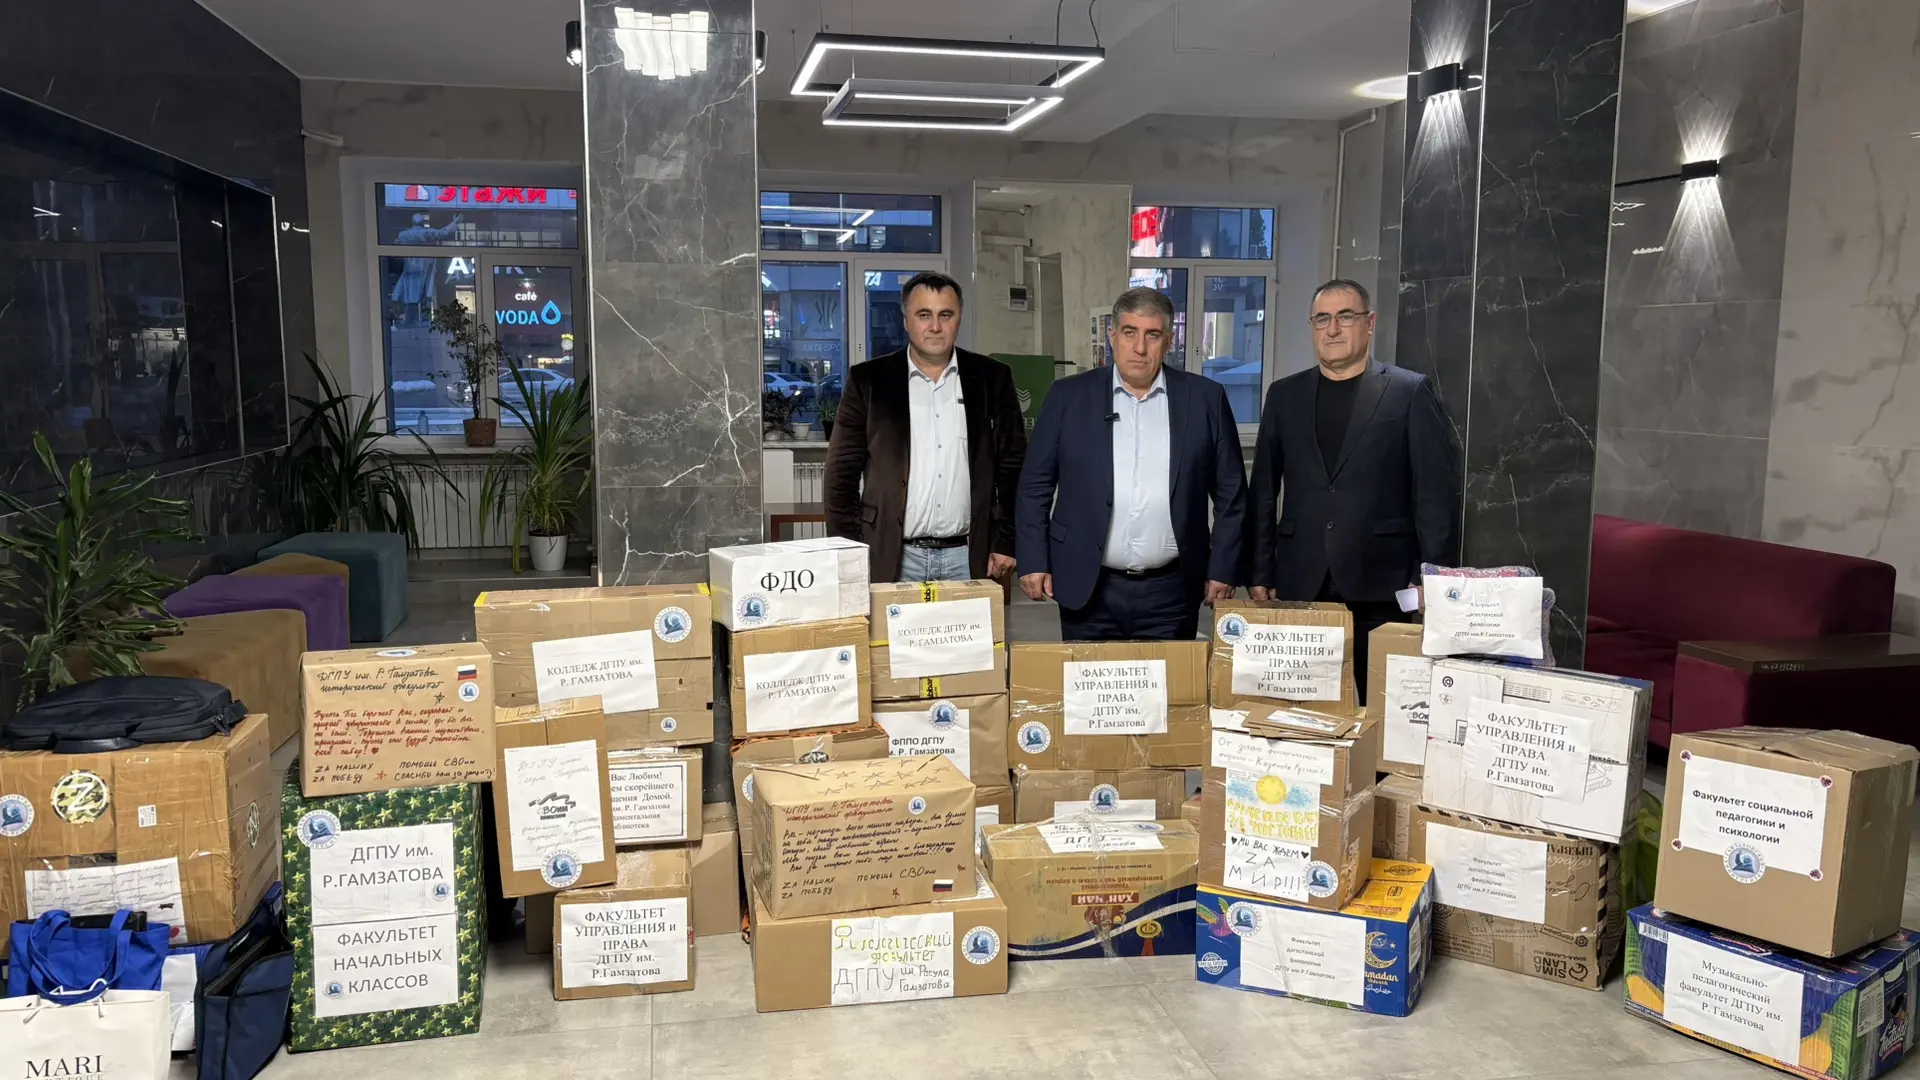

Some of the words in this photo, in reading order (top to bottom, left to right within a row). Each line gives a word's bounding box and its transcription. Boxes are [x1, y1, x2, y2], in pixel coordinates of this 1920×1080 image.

[515, 292, 537, 301] café
[495, 310, 539, 325] VODA
[760, 568, 814, 595] ФДО
[898, 624, 942, 638] КОЛЛЕДЖ
[943, 623, 966, 636] ДГПУ
[1254, 632, 1325, 643] ФАКУЛЬТЕТ
[908, 638, 918, 648] Р.
[920, 634, 973, 647] ГАМЗАТОВА
[1245, 644, 1325, 656] УПРАВЛЕНИЯ
[547, 662, 597, 676] КОЛЛЕДЖ
[599, 658, 626, 671] ДГПУ
[1269, 658, 1308, 669] ПРАВА
[560, 678, 570, 687] Р.
[571, 670, 634, 686] ГАМЗАТОВА
[1082, 667, 1148, 678] ФАКУЛЬТЕТ
[1262, 671, 1295, 682] ДГПУ
[1297, 673, 1313, 681] им.
[756, 675, 804, 692] КОЛЛЕДЖ
[806, 673, 831, 686] ДГПУ
[1073, 680, 1149, 691] УПРАВЛЕНИЯ
[1257, 683, 1318, 694] Р.Гамзатова
[768, 690, 777, 700] Р.
[778, 684, 837, 698] ГАМЗАТОВА
[1097, 693, 1135, 703] ПРАВА
[1092, 707, 1122, 718] ДГПУ
[1125, 707, 1141, 715] им.
[1088, 719, 1146, 729] Р.Гамзатова
[1488, 712, 1568, 736] ФАКУЛЬТЕТ
[892, 738, 919, 746] ФППО
[921, 737, 945, 746] ДГПУ
[1476, 724, 1565, 751] УПРАВЛЕНИЯ
[1569, 745, 1576, 753] и
[1501, 743, 1545, 761] ПРАВА
[1492, 757, 1528, 772] ДГПУ
[1532, 767, 1550, 777] им.
[611, 773, 626, 781] Вас
[628, 772, 662, 781] Любим!
[1487, 770, 1554, 793] Р.Гамзатова
[625, 783, 674, 792] скорейшего
[642, 793, 672, 802] Домой.
[1692, 789, 1746, 808] Факультет
[1747, 801, 1813, 820] социальной
[1715, 810, 1776, 830] педагогики
[1778, 822, 1785, 830] и
[1718, 825, 1780, 845] психологии
[1253, 840, 1268, 851] ВАС
[350, 844, 401, 864] ДГПУ
[405, 846, 434, 857] им.
[323, 867, 444, 888] Р.ГАМЗАТОВА
[585, 907, 666, 922] ФАКУЛЬТЕТ
[337, 925, 438, 946] ФАКУЛЬТЕТ
[575, 922, 666, 937] УПРАВЛЕНИЯ
[669, 924, 676, 932] и
[603, 939, 648, 951] ПРАВА
[333, 948, 442, 971] НАЧАЛЬНЫХ
[596, 953, 633, 965] ДГПУ
[636, 954, 655, 963] им.
[1534, 955, 1567, 969] LAND
[592, 967, 661, 979] Р.Гамзатова
[833, 967, 895, 994] ДГПУ
[919, 964, 949, 977] Расула
[1364, 971, 1398, 981] amadan
[1534, 964, 1566, 979] SIMA
[1701, 959, 1769, 990] Музыкально-
[349, 974, 428, 994] КЛАССОВ
[900, 979, 949, 992] Гамзатова
[1692, 972, 1771, 1006] педагогический
[1679, 980, 1729, 1007] факультет
[1731, 995, 1763, 1015] ДГПУ
[1766, 1011, 1784, 1023] им.
[1701, 1002, 1710, 1013] Р.
[1713, 1006, 1764, 1032] Гамзатова
[25, 1054, 103, 1079] MARI
